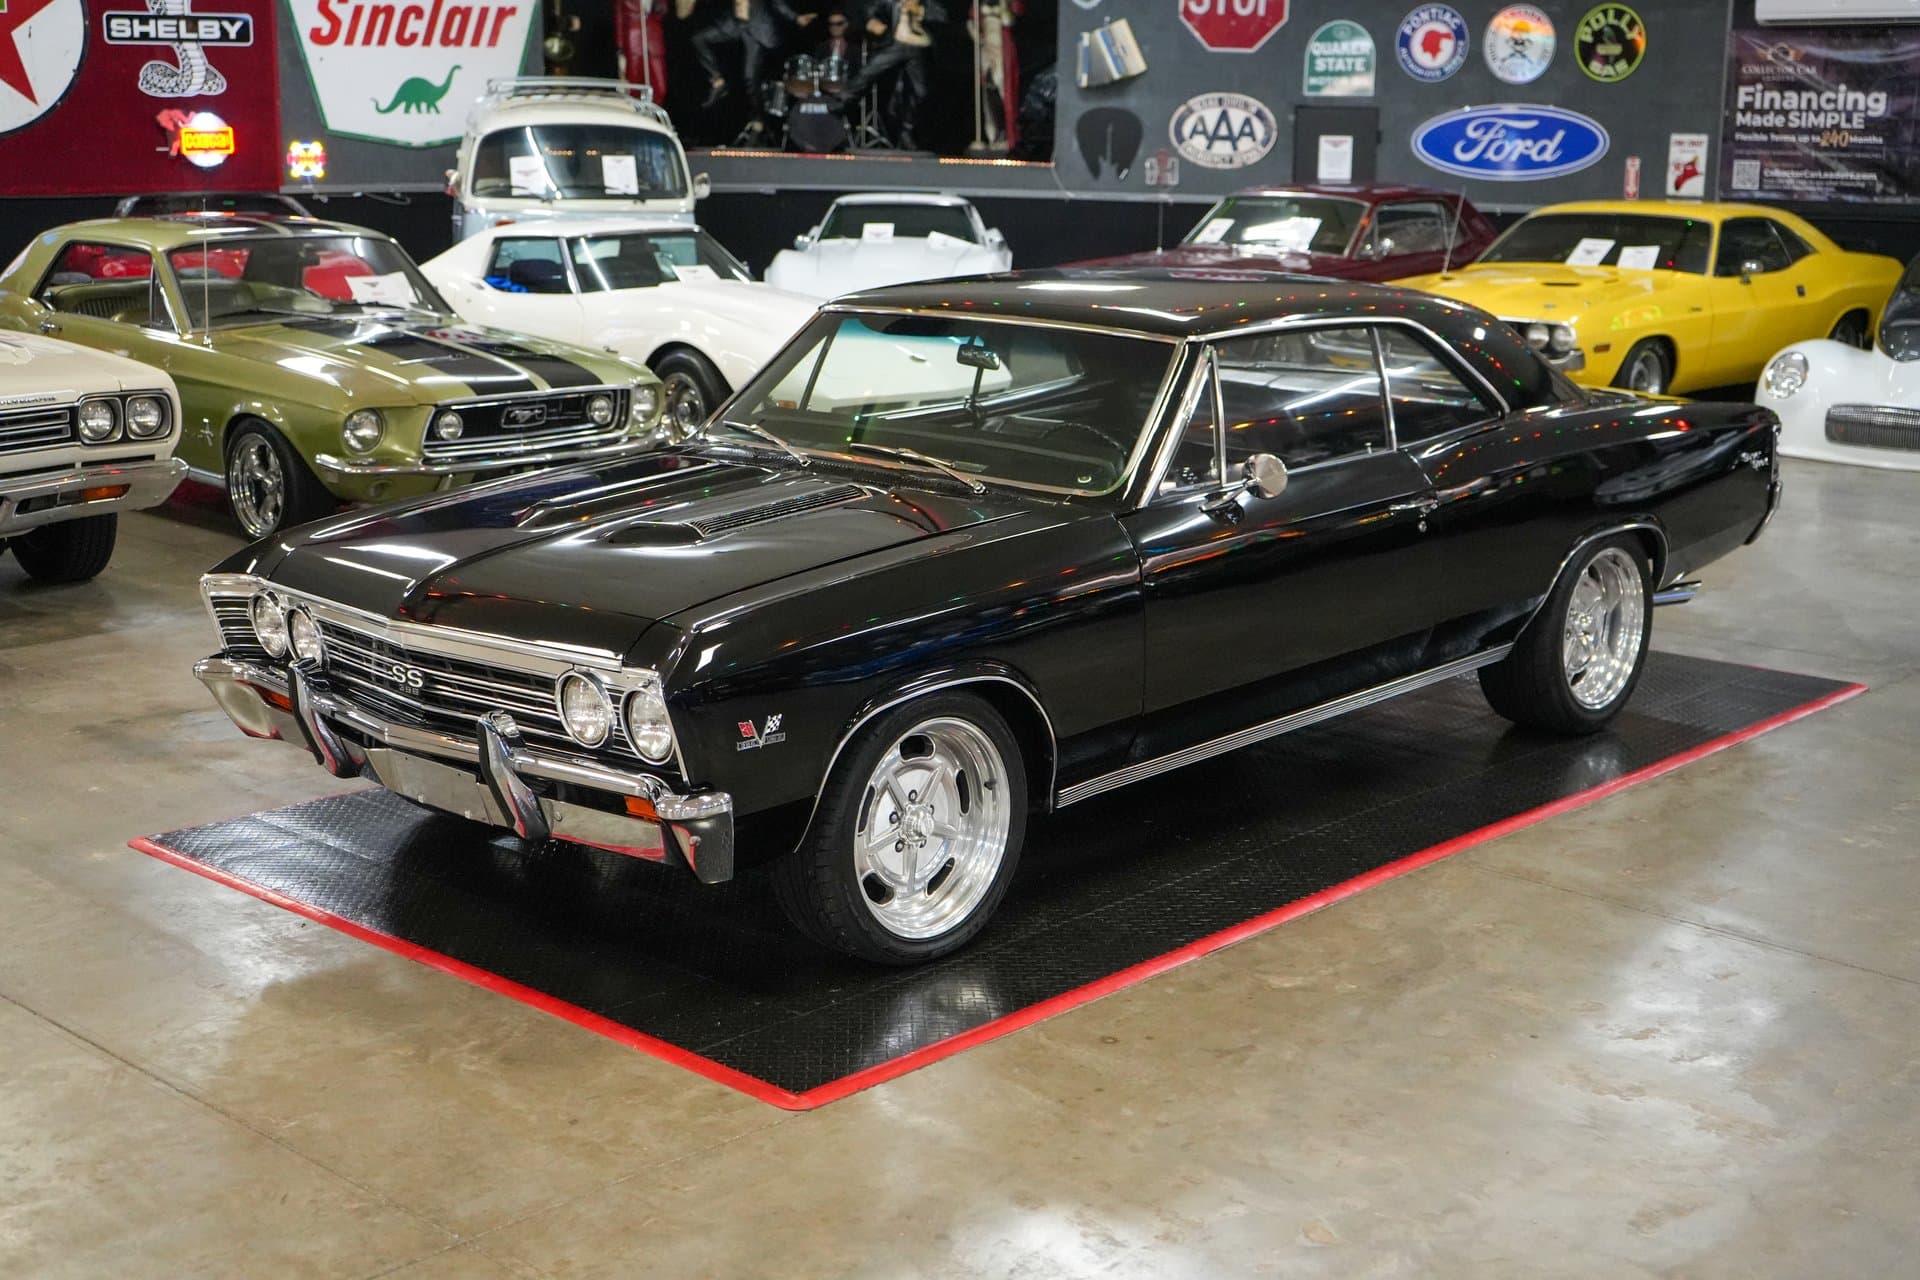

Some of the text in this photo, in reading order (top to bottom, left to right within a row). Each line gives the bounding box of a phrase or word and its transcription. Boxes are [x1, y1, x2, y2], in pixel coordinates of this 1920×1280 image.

[110, 18, 243, 40] SHELBY
[309, 0, 518, 48] Sinclair
[1401, 8, 1462, 35] PONTIAC
[1580, 8, 1644, 43] POLLY
[1315, 57, 1366, 72] STATE
[1589, 59, 1629, 78] GAS
[1737, 83, 1888, 117] Financing
[1189, 109, 1257, 151] AAA
[1736, 111, 1865, 129] Made SIMPLE
[1454, 117, 1566, 162] Ford
[1735, 132, 1768, 142] Flexible
[1770, 133, 1796, 143] Terms
[1820, 130, 1849, 148] 240
[1850, 135, 1883, 145] Months
[392, 665, 423, 688] SS
